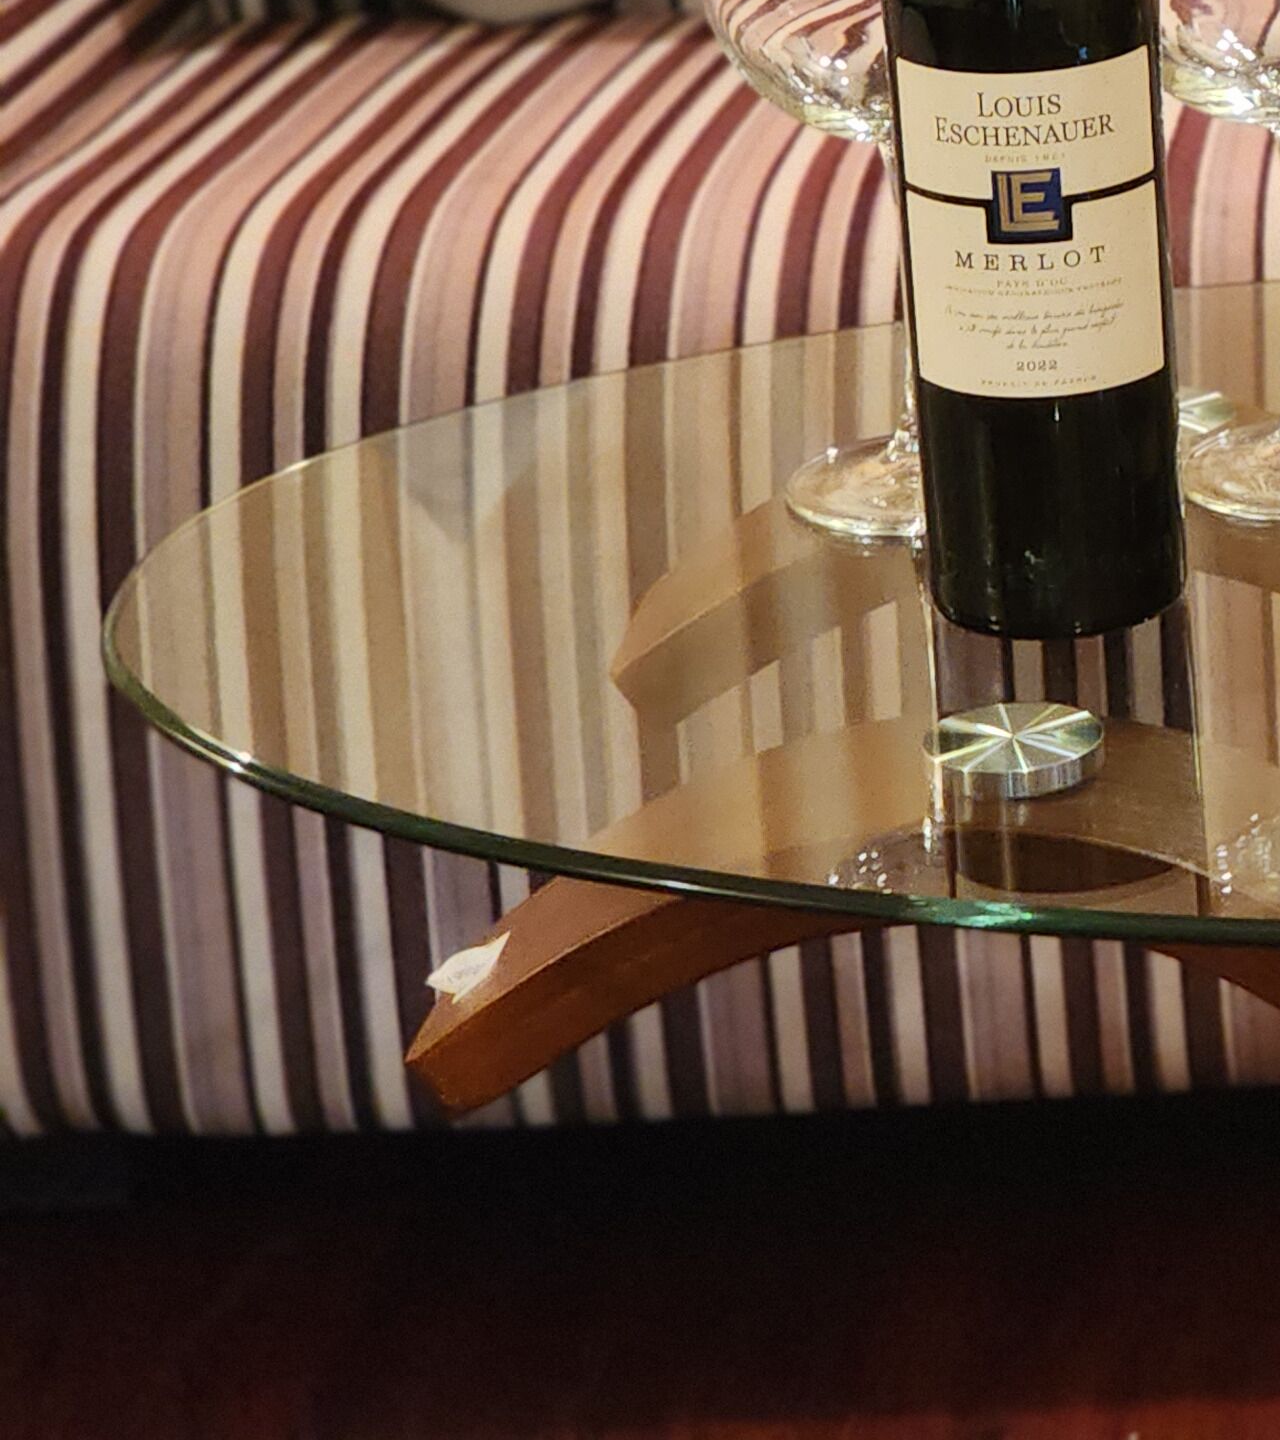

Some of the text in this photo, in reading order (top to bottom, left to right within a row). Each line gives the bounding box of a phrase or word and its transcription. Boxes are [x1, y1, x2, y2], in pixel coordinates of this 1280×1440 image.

[977, 92, 1061, 118] LOUIS
[935, 113, 1115, 147] ESCHENAUER
[955, 245, 1105, 272] MERLOT
[1016, 360, 1058, 372] 2022
